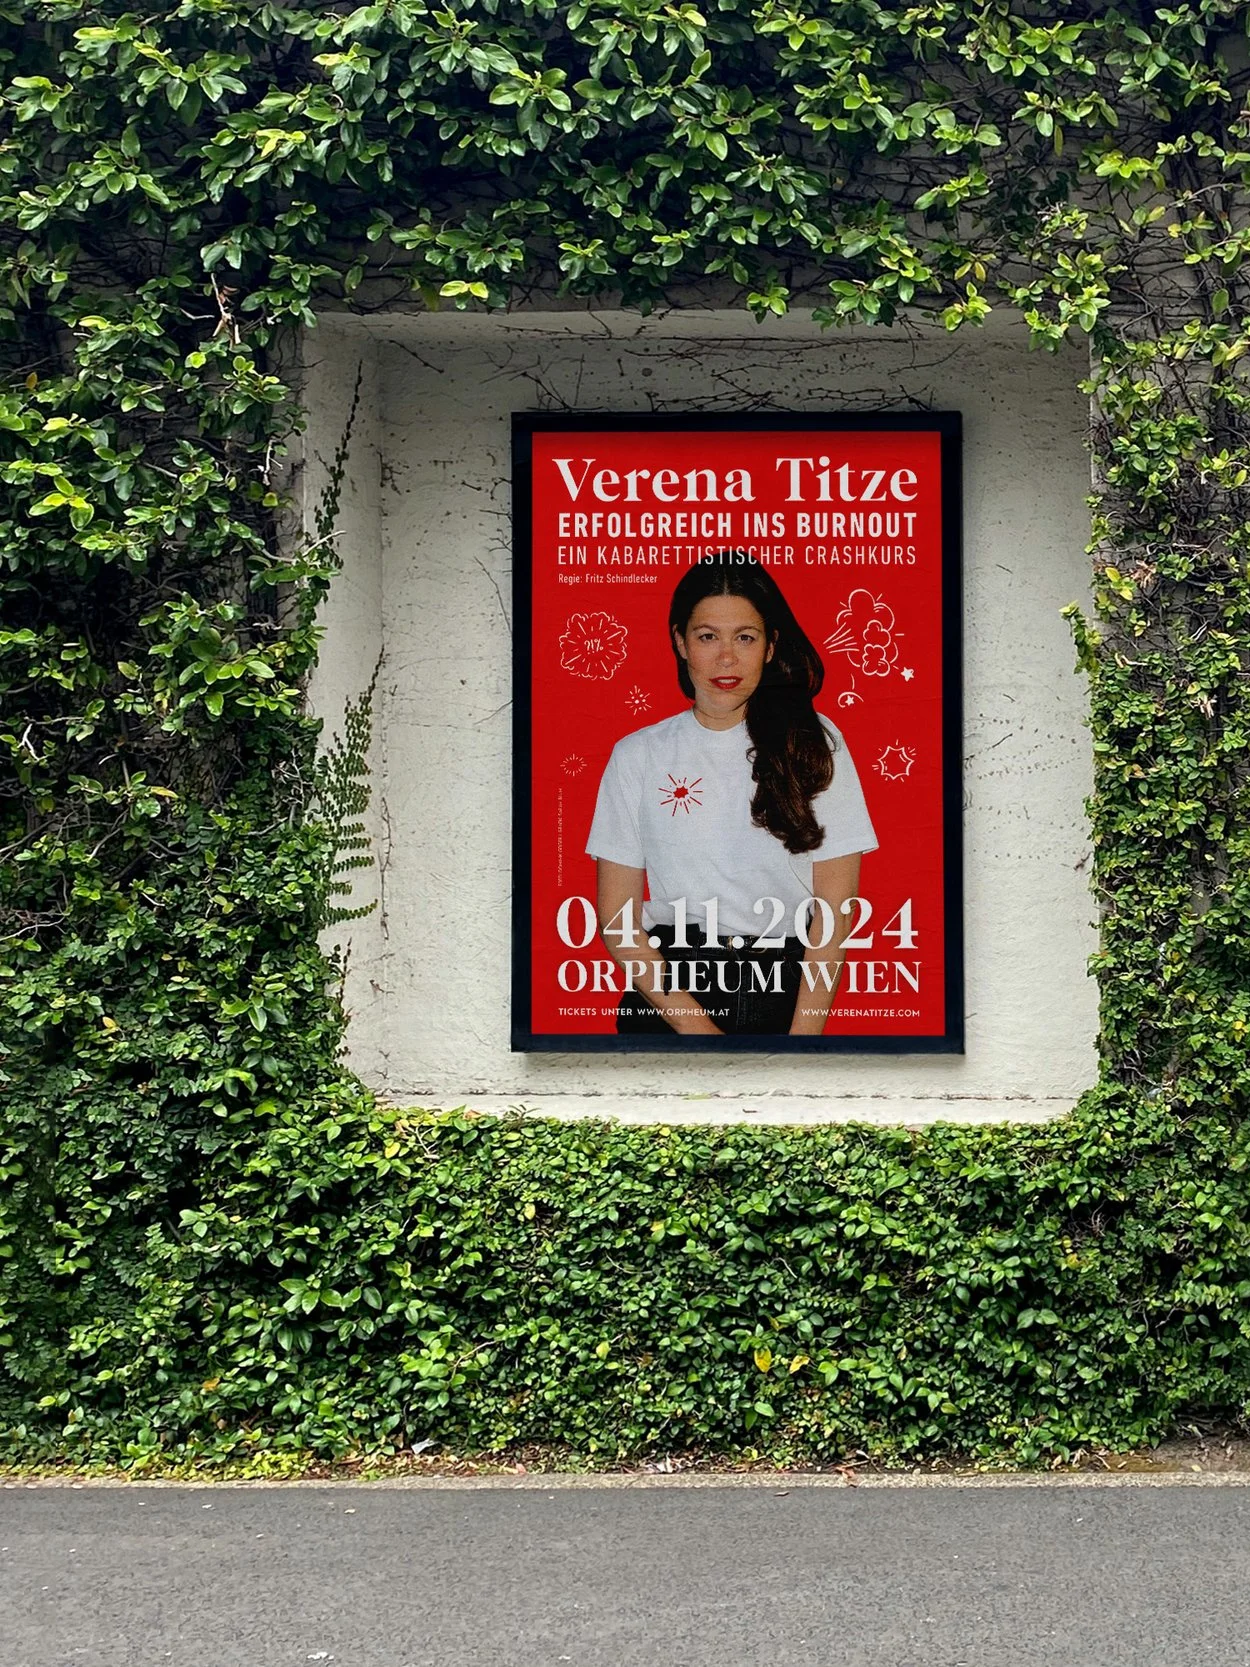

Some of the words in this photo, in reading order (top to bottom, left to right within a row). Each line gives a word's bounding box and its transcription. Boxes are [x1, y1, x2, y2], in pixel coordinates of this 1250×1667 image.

[552, 457, 756, 502] Verena
[775, 455, 918, 502] Titze
[558, 512, 732, 538] ERFOLGREICH
[743, 512, 785, 538] INS
[797, 512, 917, 538] BURNOUT
[558, 545, 587, 565] EIN
[597, 545, 795, 565] KABARETTISTISCHER
[805, 545, 916, 565] CRASHKURS
[558, 573, 582, 585] Regie:
[585, 573, 604, 583] Fritz
[606, 573, 657, 583] Schindlecker
[556, 895, 919, 950] 04.11.2024
[557, 959, 786, 994] ORPHEUM
[797, 959, 922, 994] WIEN
[558, 1007, 597, 1016] TICKETS
[601, 1007, 633, 1016] UNTER
[637, 1007, 730, 1017] WWW.ORPHEUM.AT
[801, 1008, 920, 1017] WWW.VERENATITZE.COM
